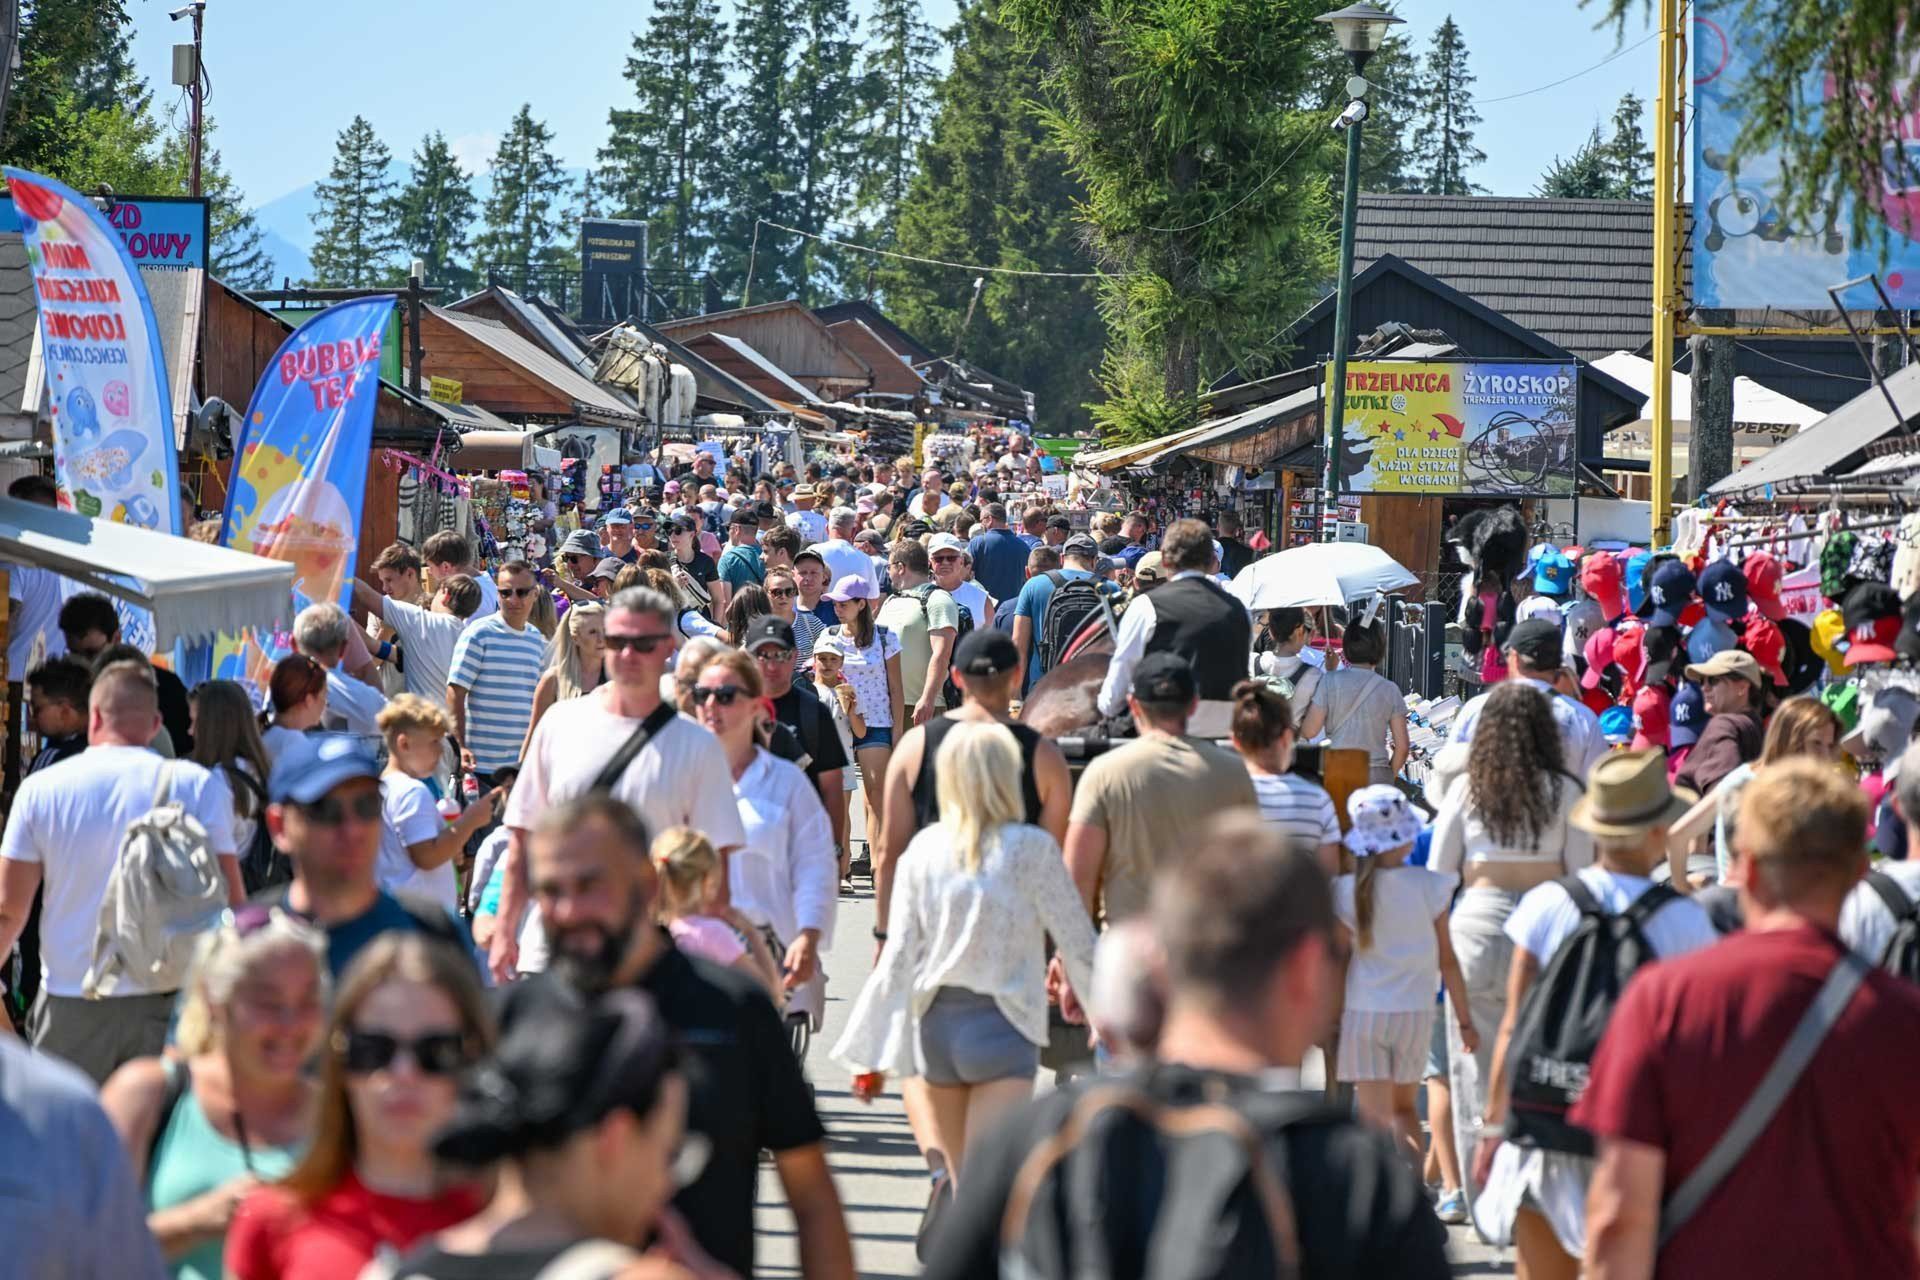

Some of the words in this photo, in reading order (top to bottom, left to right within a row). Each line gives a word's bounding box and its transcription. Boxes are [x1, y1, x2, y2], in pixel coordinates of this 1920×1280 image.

[108, 203, 142, 229] ZD
[121, 232, 191, 259] OWY
[281, 331, 380, 386] BUBBLE
[309, 373, 356, 413] TEA
[1346, 372, 1451, 393] TRZELNICA
[1464, 371, 1570, 395] ŻYROSKOP
[1508, 395, 1526, 405] DLA
[1397, 447, 1419, 459] DLA
[1422, 447, 1460, 459] DZIECI
[1378, 458, 1413, 471] KAŻDY
[1400, 474, 1459, 486] WYGRANY!
